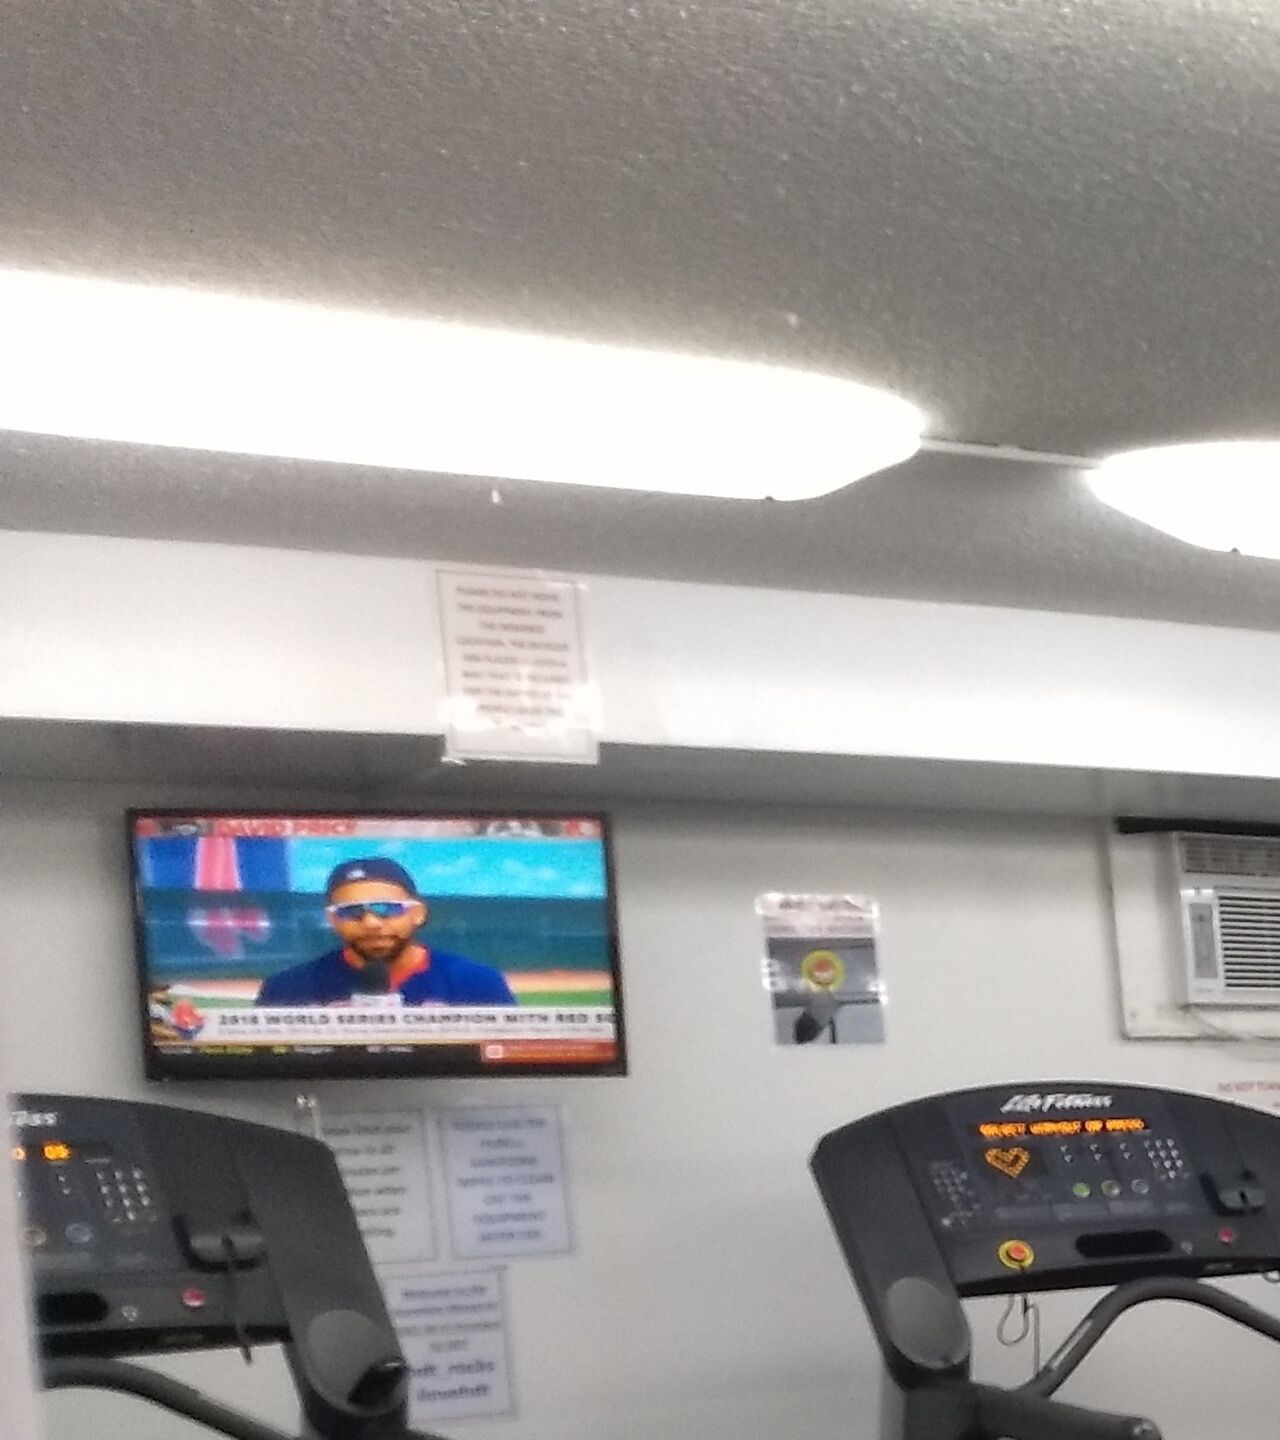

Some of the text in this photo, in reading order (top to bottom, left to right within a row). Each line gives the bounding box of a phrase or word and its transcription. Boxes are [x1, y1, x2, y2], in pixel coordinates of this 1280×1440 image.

[265, 1014, 330, 1025] WORLD
[336, 1014, 397, 1025] SERIES
[402, 1013, 497, 1024] CHAMPION
